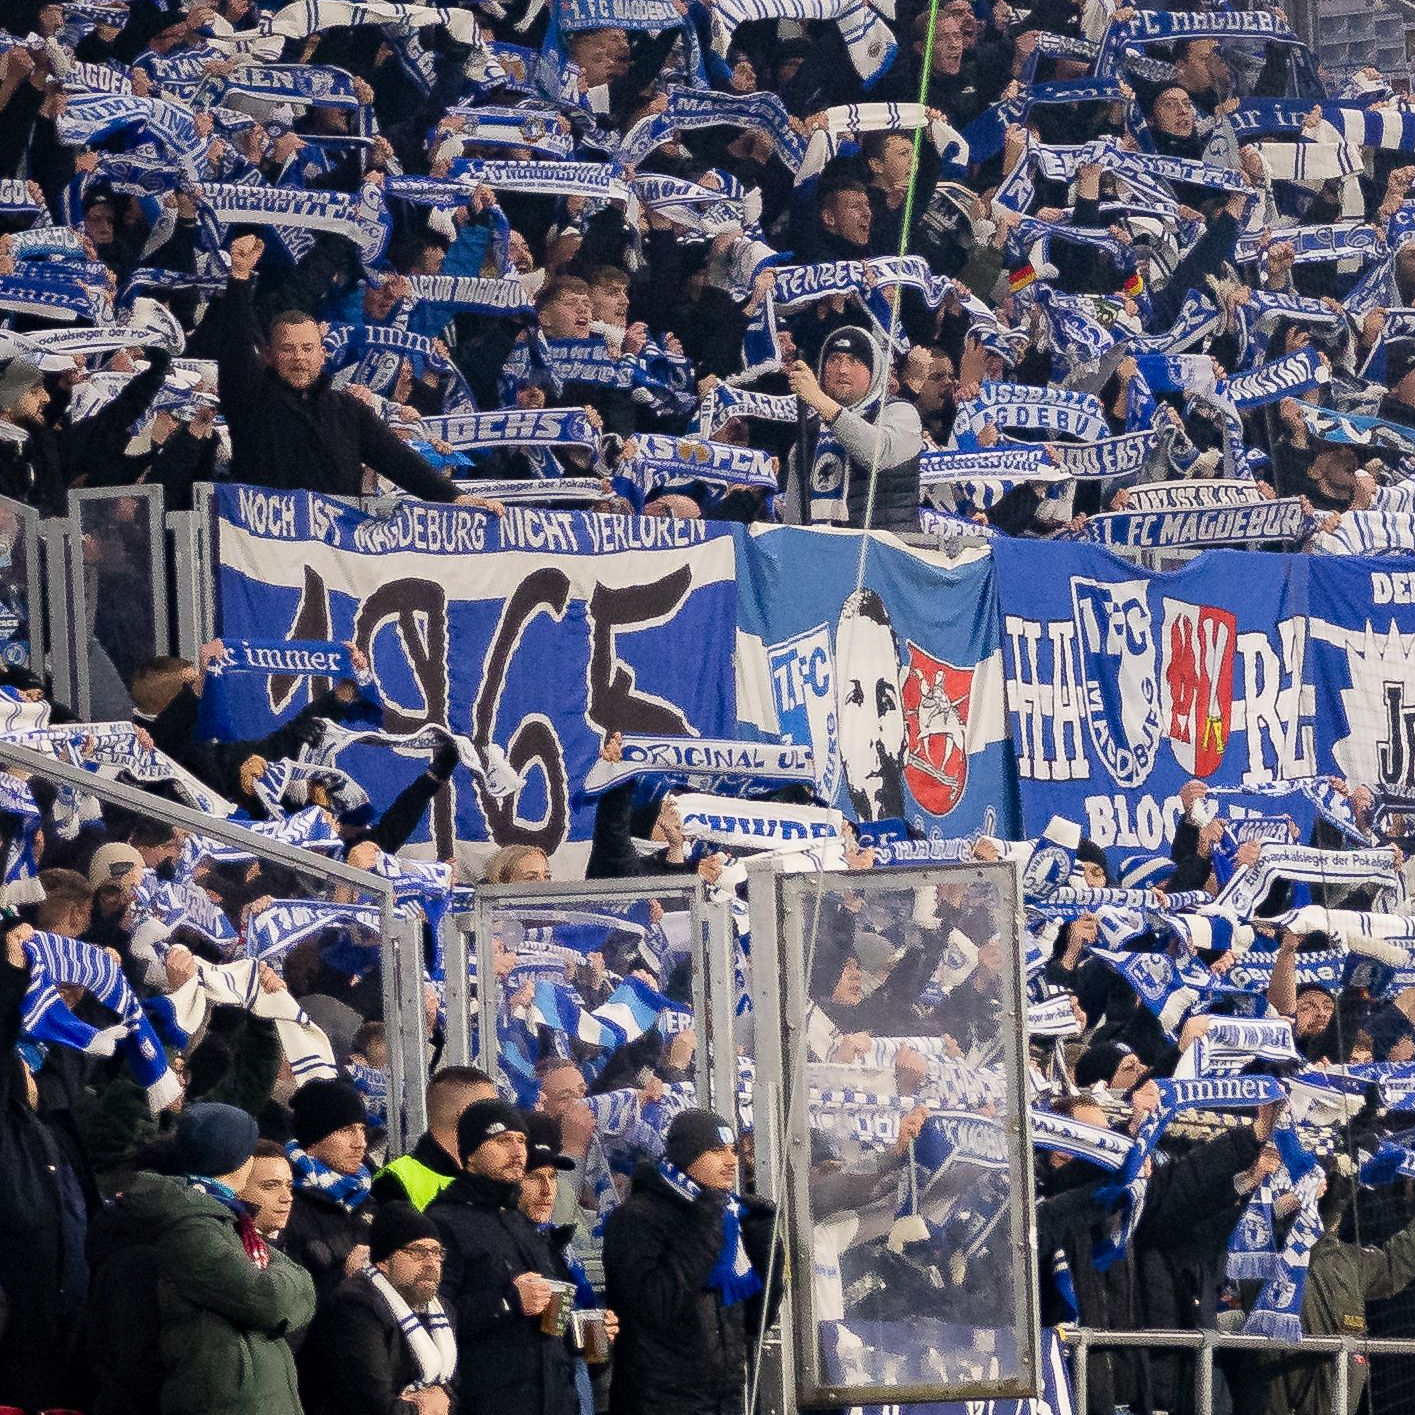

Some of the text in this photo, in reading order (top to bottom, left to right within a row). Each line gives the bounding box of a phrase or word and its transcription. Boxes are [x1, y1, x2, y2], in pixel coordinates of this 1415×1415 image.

[1129, 12, 1162, 35] FC
[776, 262, 867, 295] TENBER
[446, 412, 564, 444] OCHS
[714, 449, 773, 476] FCM
[1103, 439, 1146, 474] EAST
[239, 492, 296, 537] NOCH
[309, 507, 342, 544] IST
[500, 508, 579, 550] NICHT
[588, 516, 708, 551] VERLOREN
[1127, 511, 1159, 535] FC
[243, 643, 341, 671] immer
[624, 744, 766, 769] ORIGINAL
[1086, 795, 1184, 848] BLOC
[1332, 851, 1351, 866] der
[1172, 1076, 1271, 1101] immer
